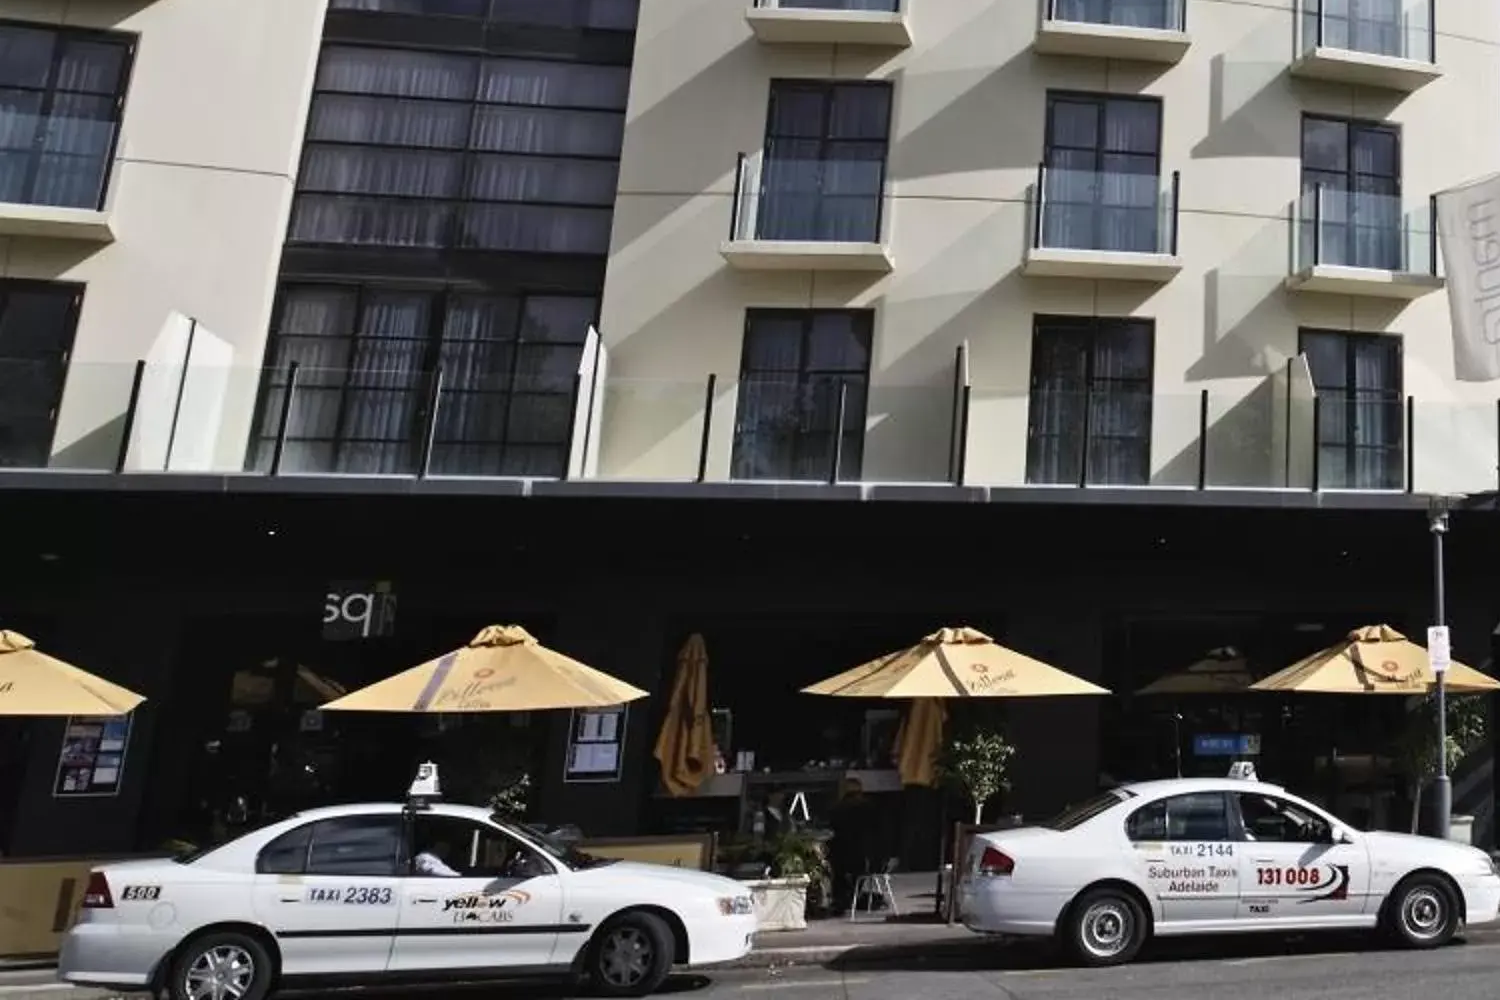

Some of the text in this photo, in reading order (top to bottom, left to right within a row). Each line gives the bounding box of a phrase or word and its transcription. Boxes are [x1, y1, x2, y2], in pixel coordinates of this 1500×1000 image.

[1170, 843, 1233, 857] TAXI 2144
[1148, 866, 1205, 879] Suburban
[1257, 867, 1319, 885] 131 008
[1168, 880, 1219, 892] Adelaide
[310, 887, 392, 905] TAXI 2383
